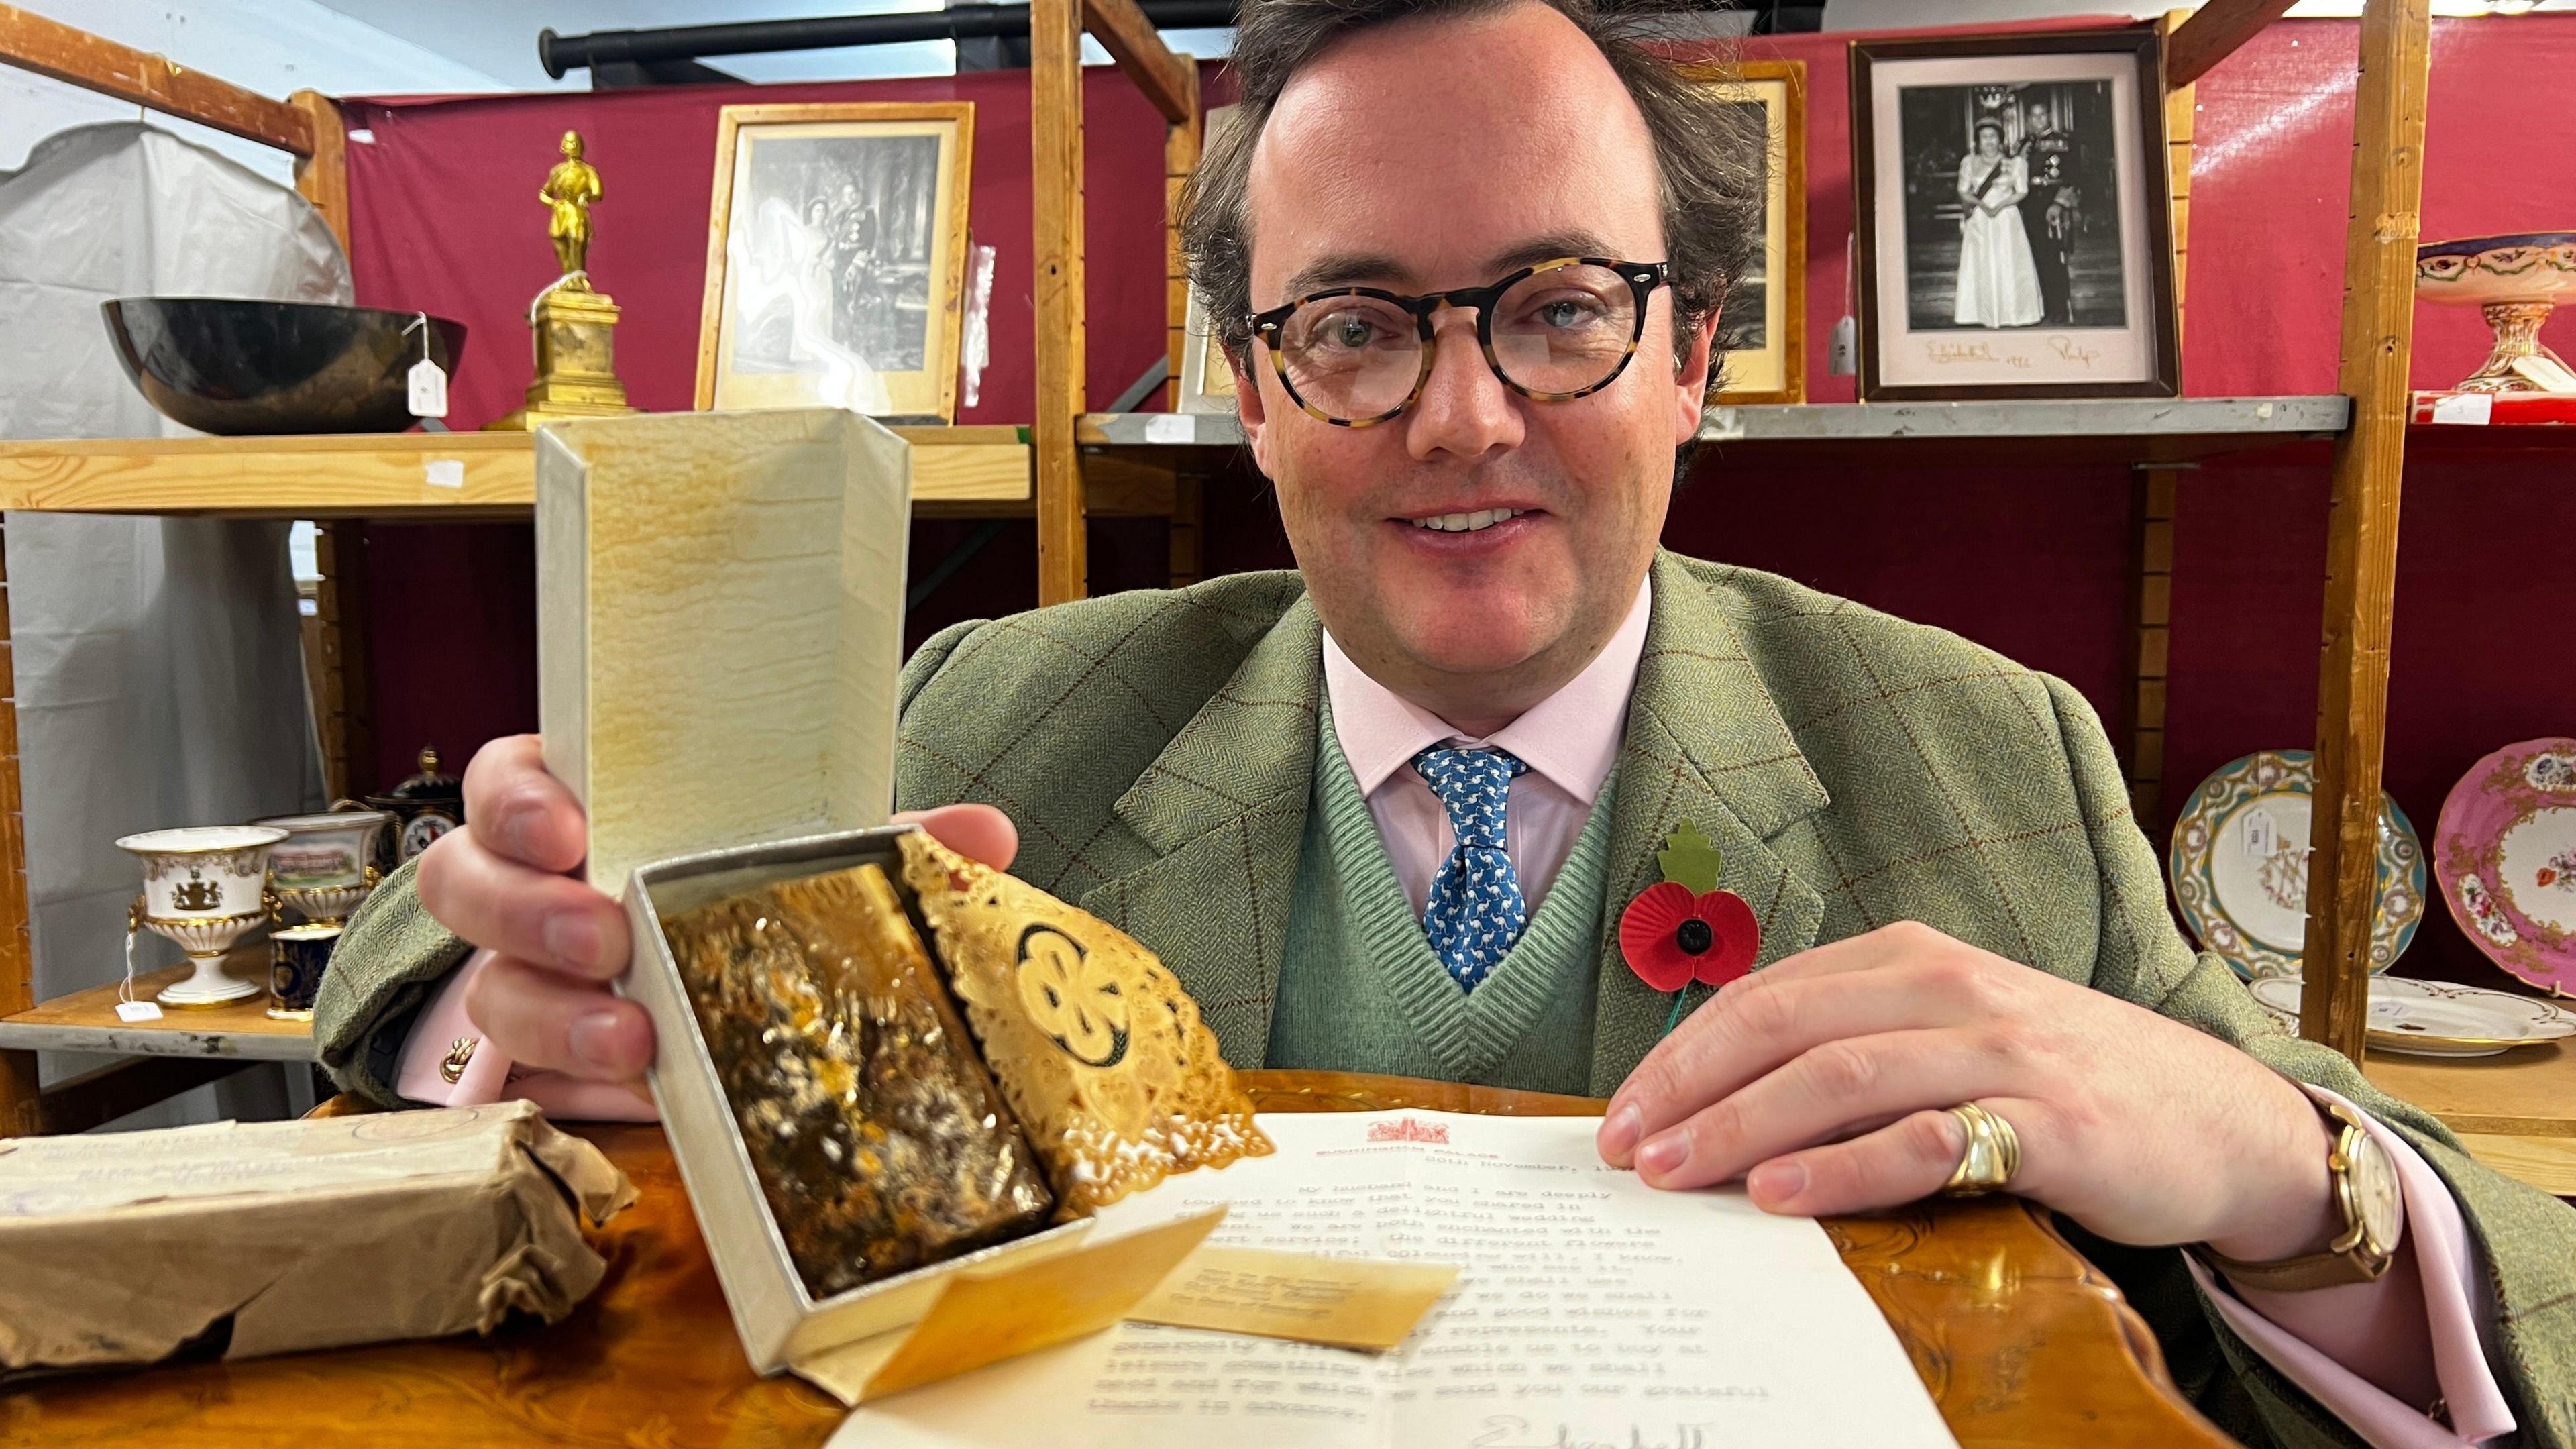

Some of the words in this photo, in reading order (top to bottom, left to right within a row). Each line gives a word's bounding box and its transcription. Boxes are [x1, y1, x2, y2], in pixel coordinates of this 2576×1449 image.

[1316, 1146, 1425, 1156] BUCKINGHAM
[1434, 1149, 1499, 1159] PALACE
[1299, 1185, 1322, 1194] My
[1333, 1181, 1412, 1192] husband
[1423, 1184, 1459, 1193] and
[1541, 1191, 1612, 1200] deeply
[1308, 1197, 1356, 1205] know
[1368, 1193, 1413, 1203] that
[1424, 1196, 1460, 1205] you
[1473, 1199, 1545, 1210] shared
[1556, 1202, 1581, 1211] in
[1376, 1205, 1495, 1220] delightful
[1508, 1214, 1595, 1224] wedding
[1437, 1222, 1549, 1235] enchanted
[1559, 1227, 1612, 1236] with
[1624, 1228, 1661, 1236] the
[1389, 1232, 1424, 1242] the
[1436, 1236, 1552, 1248] different
[1564, 1239, 1655, 1249] flowers
